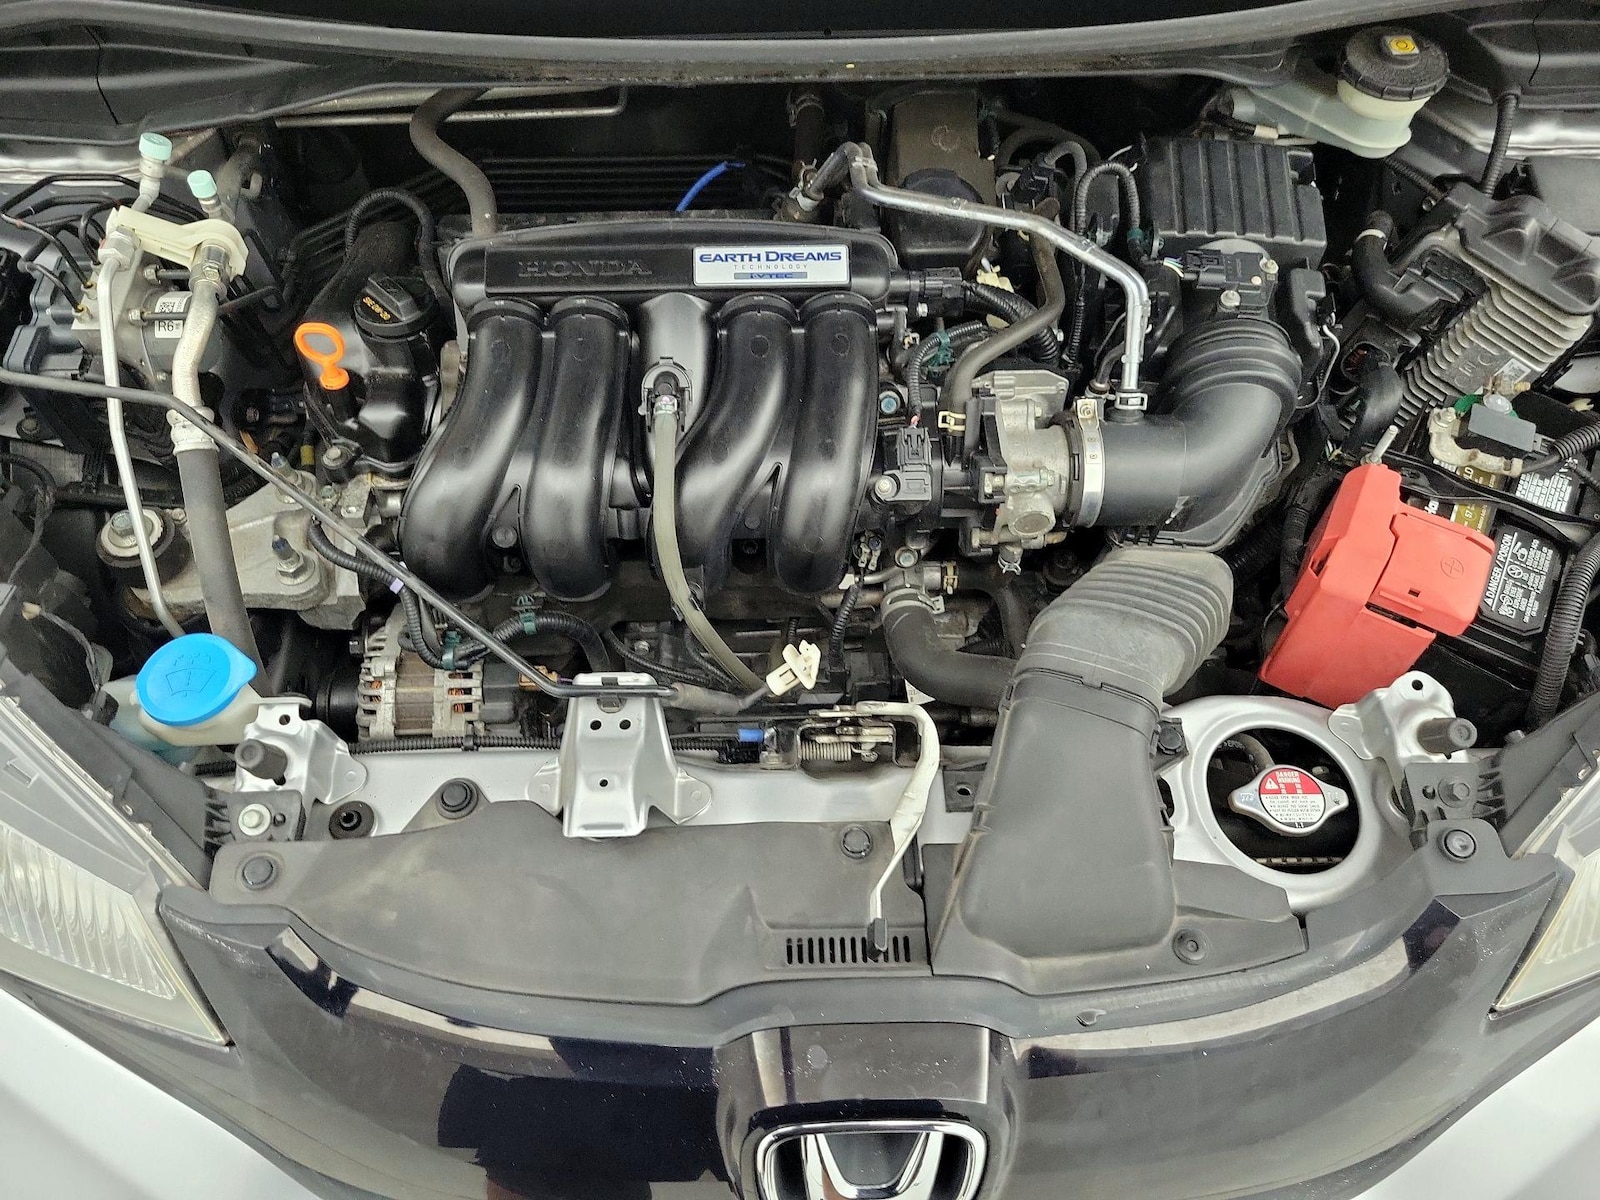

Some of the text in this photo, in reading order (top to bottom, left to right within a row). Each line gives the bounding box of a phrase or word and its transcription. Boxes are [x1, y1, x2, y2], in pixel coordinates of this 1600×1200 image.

[700, 251, 842, 262] EARTH DREAMS
[518, 259, 652, 277] HONDA
[158, 320, 174, 332] R6
[1485, 566, 1502, 597] DANGER
[1496, 533, 1512, 561] POISON
